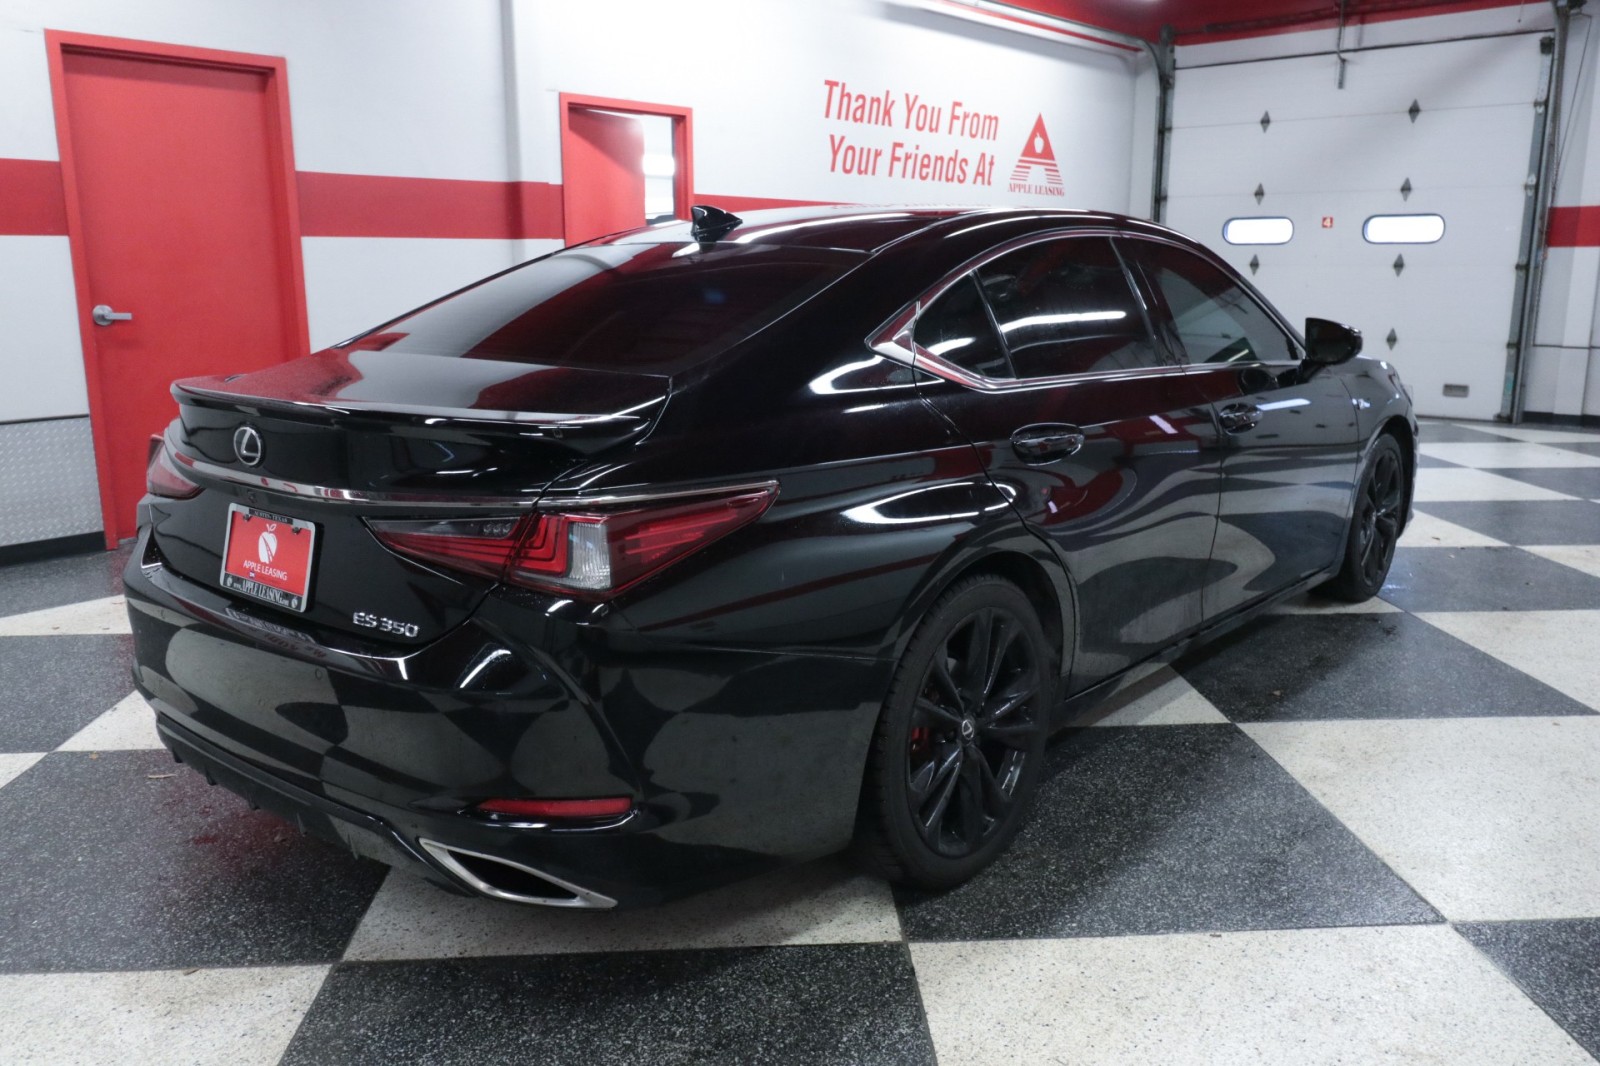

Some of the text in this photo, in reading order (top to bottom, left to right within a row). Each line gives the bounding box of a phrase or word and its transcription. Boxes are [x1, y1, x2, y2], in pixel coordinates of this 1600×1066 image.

[824, 79, 999, 141] Thank You From
[829, 134, 995, 186] Your Friends At
[1007, 183, 1065, 197] APPLE LEASING
[243, 560, 261, 573] APPLE
[261, 565, 288, 581] LEASING
[352, 612, 419, 637] ES 350
